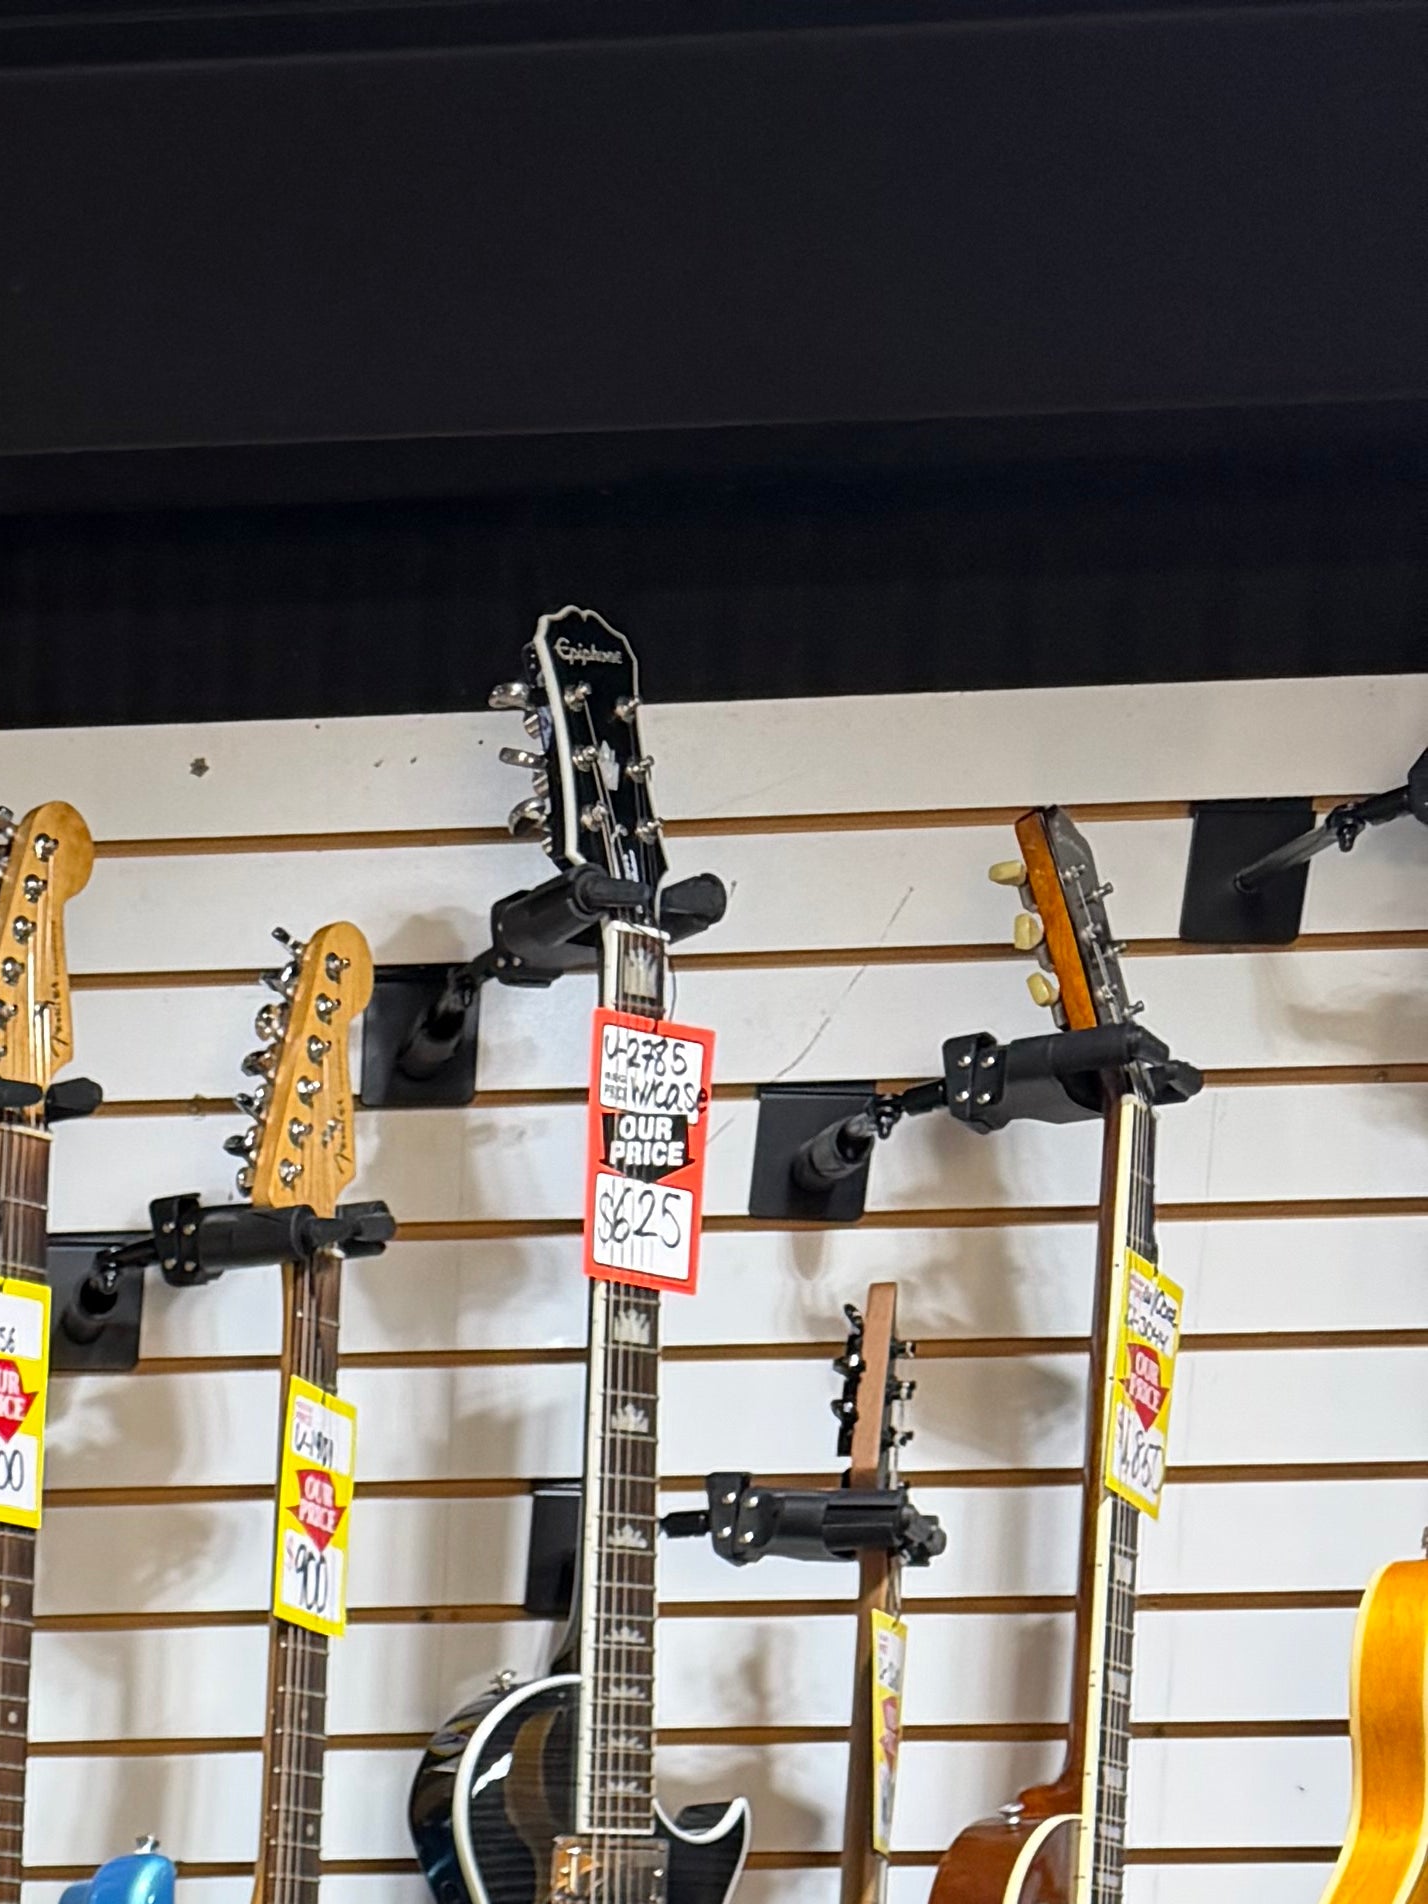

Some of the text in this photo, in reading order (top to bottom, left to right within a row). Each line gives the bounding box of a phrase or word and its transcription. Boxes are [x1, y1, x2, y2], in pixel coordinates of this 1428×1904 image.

[619, 1115, 673, 1141] OUR
[609, 1140, 685, 1167] PRICE
[598, 1184, 681, 1249] $625
[1135, 1352, 1160, 1382] OUR
[304, 1474, 334, 1508] OUR
[298, 1497, 338, 1535] PRICE
